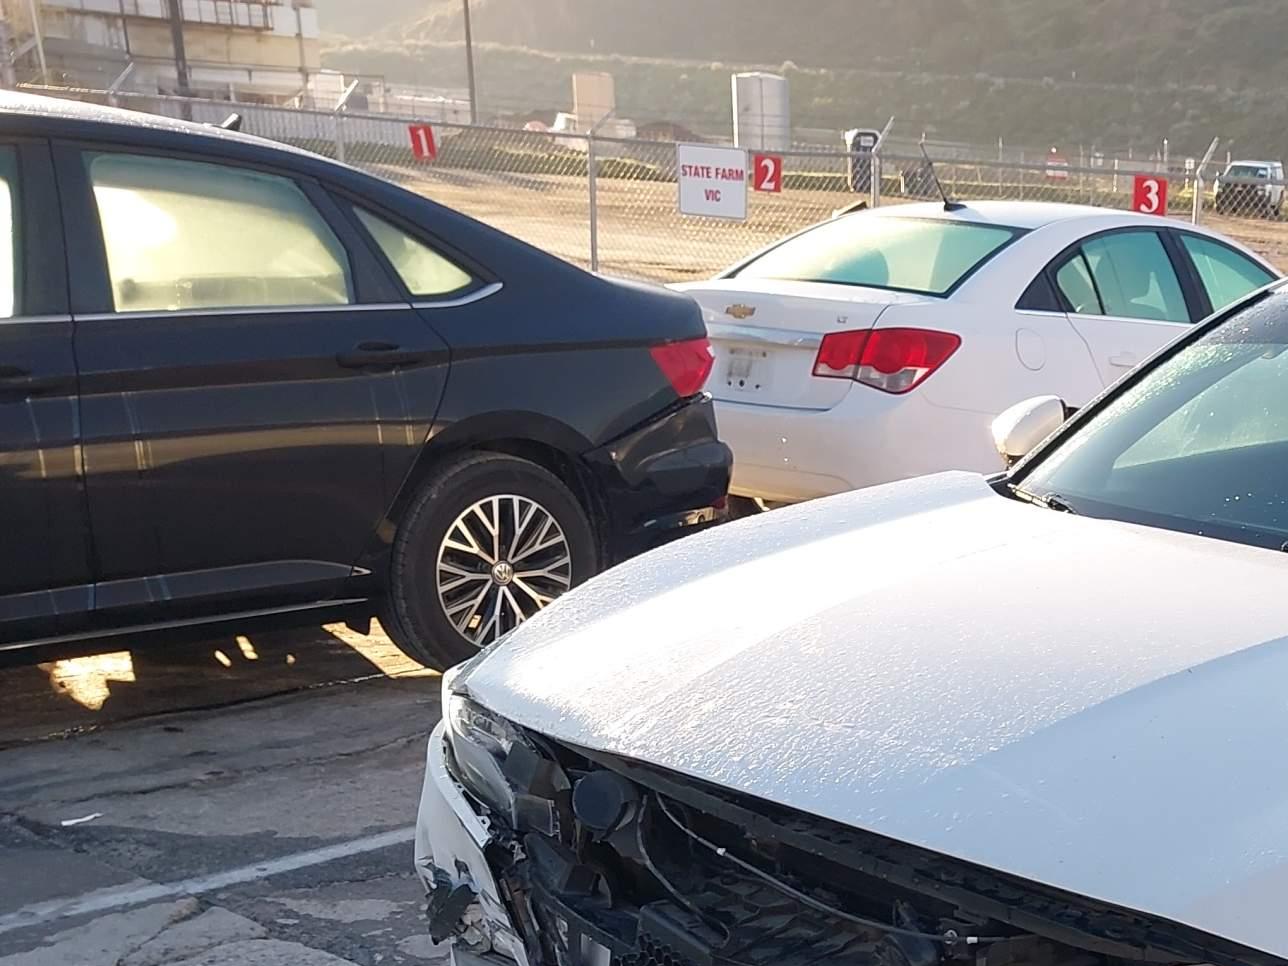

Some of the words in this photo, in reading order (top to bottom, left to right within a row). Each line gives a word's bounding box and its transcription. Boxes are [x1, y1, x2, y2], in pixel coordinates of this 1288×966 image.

[417, 127, 431, 156] 1
[681, 164, 712, 179] STATE
[715, 167, 745, 181] FARM
[760, 158, 776, 190] 2
[704, 188, 721, 202] VIC
[1139, 179, 1159, 213] 3
